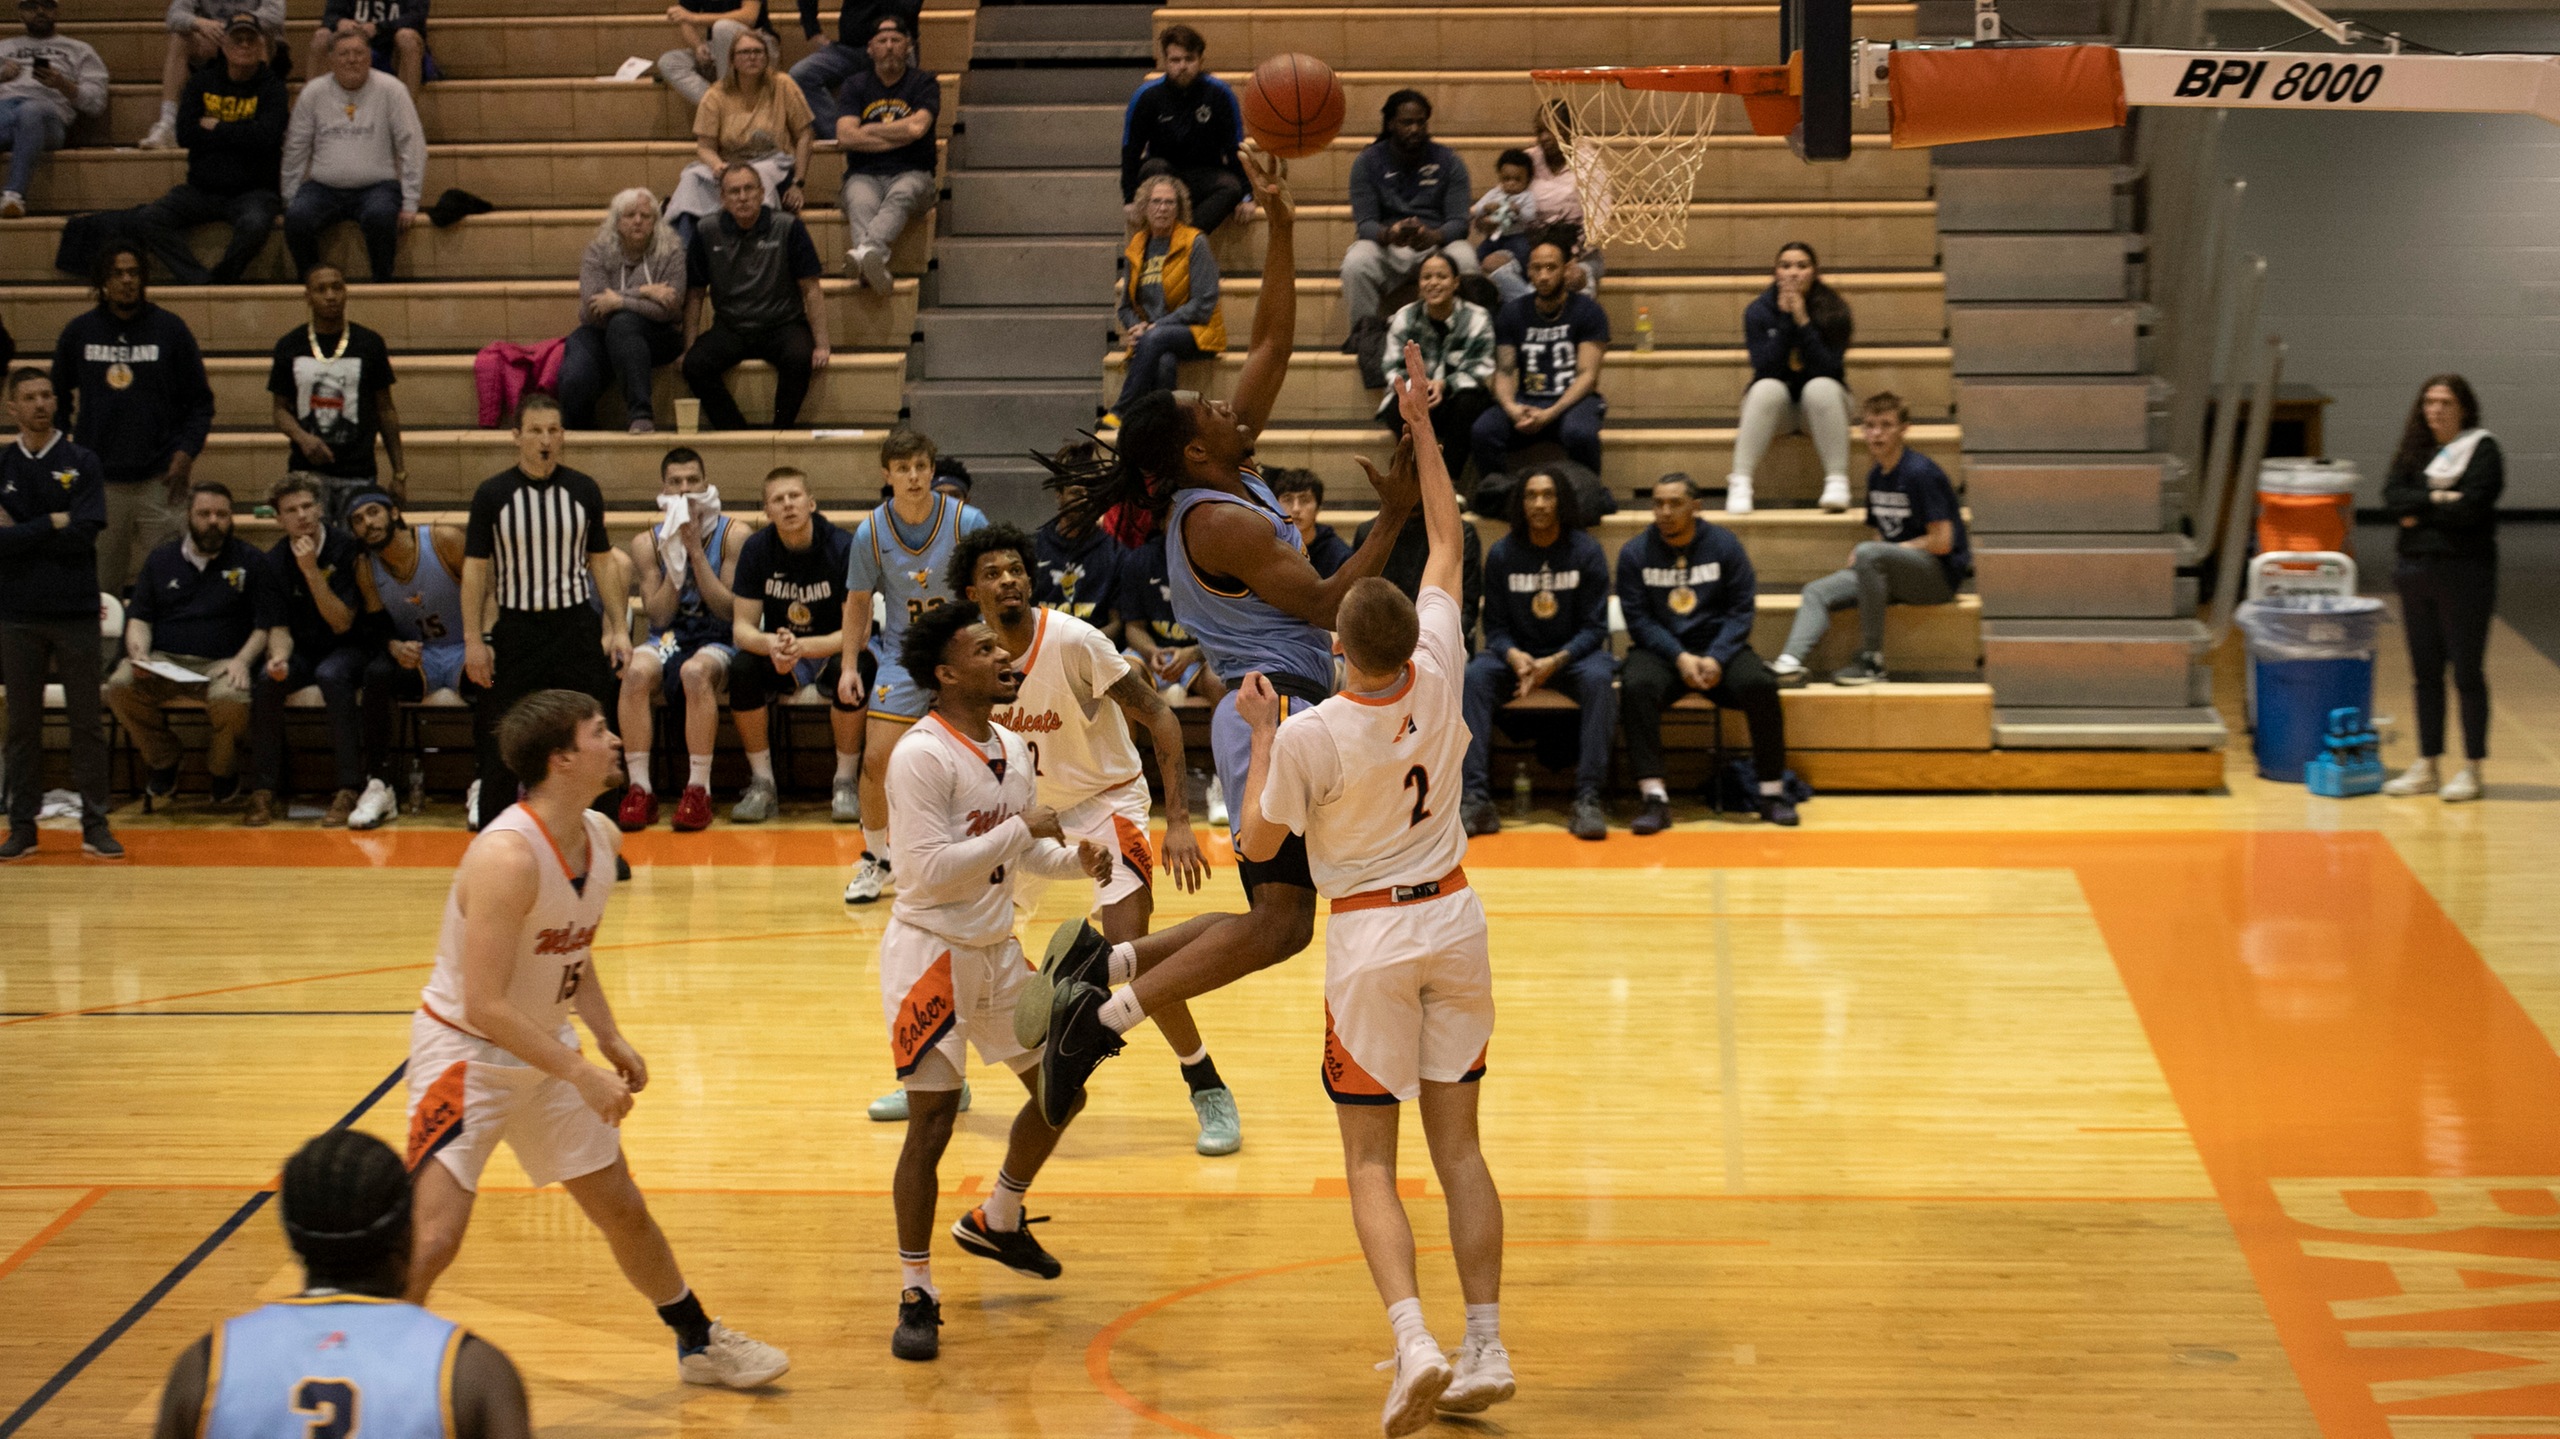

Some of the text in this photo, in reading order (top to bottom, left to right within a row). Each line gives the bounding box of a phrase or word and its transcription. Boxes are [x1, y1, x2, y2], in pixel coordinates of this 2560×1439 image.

[354, 0, 401, 24] USA
[2174, 58, 2384, 103] BPI 8000
[84, 343, 160, 363] GRACELAND
[764, 577, 832, 604] GRACLAND
[415, 613, 448, 640] 15
[1403, 763, 1433, 829] 2
[555, 960, 585, 1005] 15
[898, 994, 948, 1057] Baker
